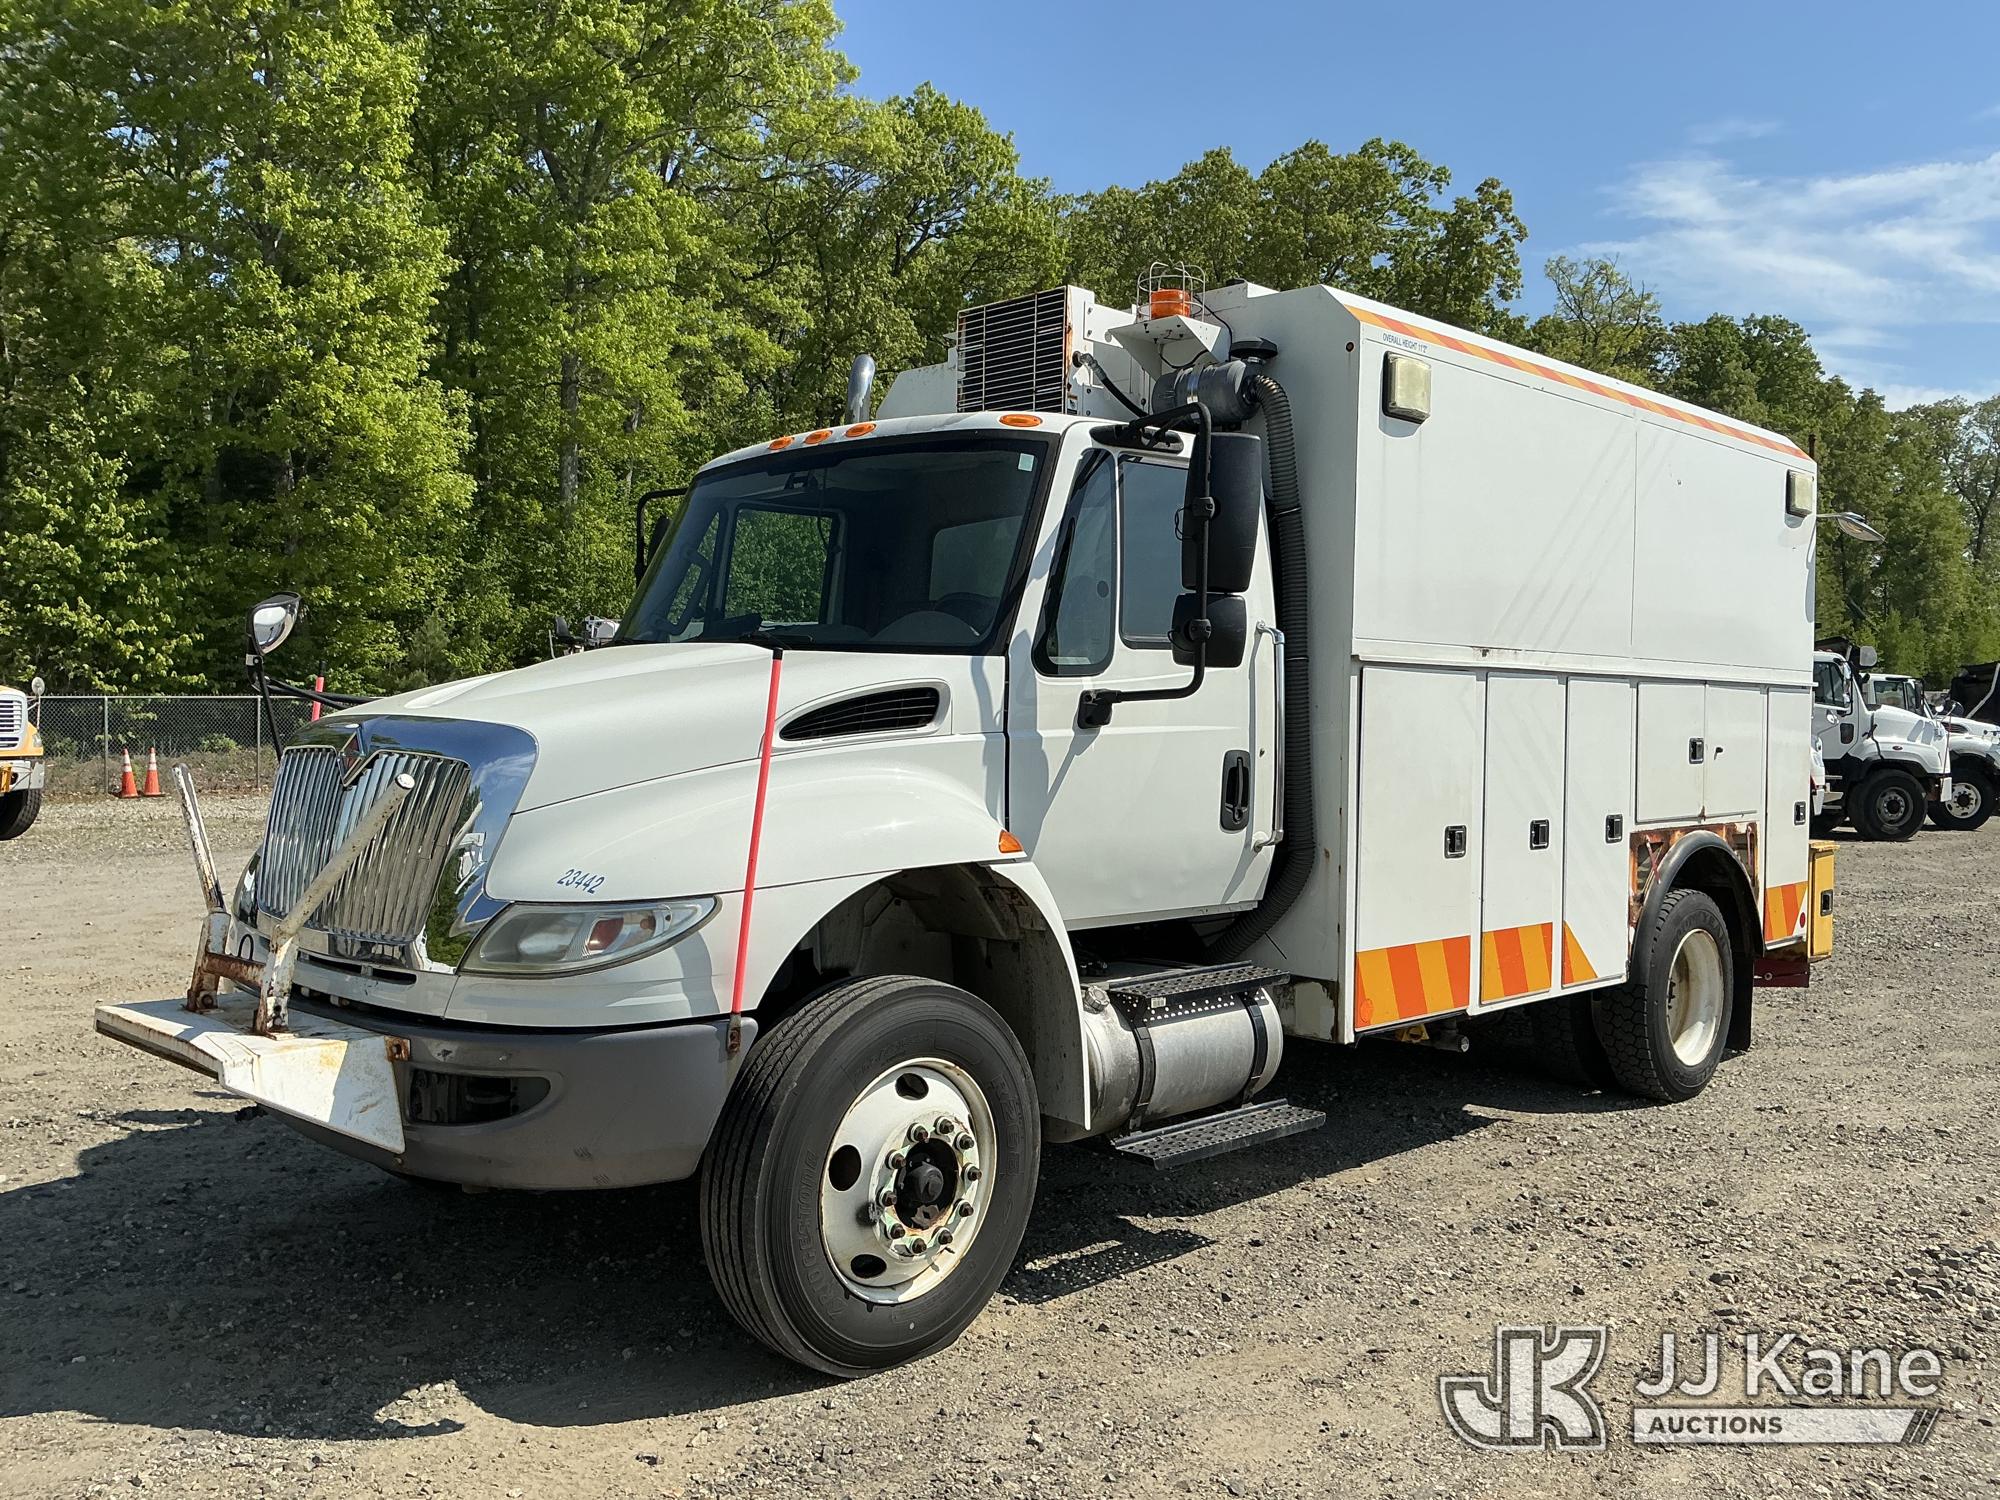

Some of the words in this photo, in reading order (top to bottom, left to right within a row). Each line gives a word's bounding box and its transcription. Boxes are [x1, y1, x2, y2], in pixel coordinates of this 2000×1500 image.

[1382, 332, 1402, 346] OVERALL
[1402, 339, 1418, 351] HEIGHT
[556, 868, 605, 894] 23442
[796, 1145, 848, 1319] BRIDGESTONE
